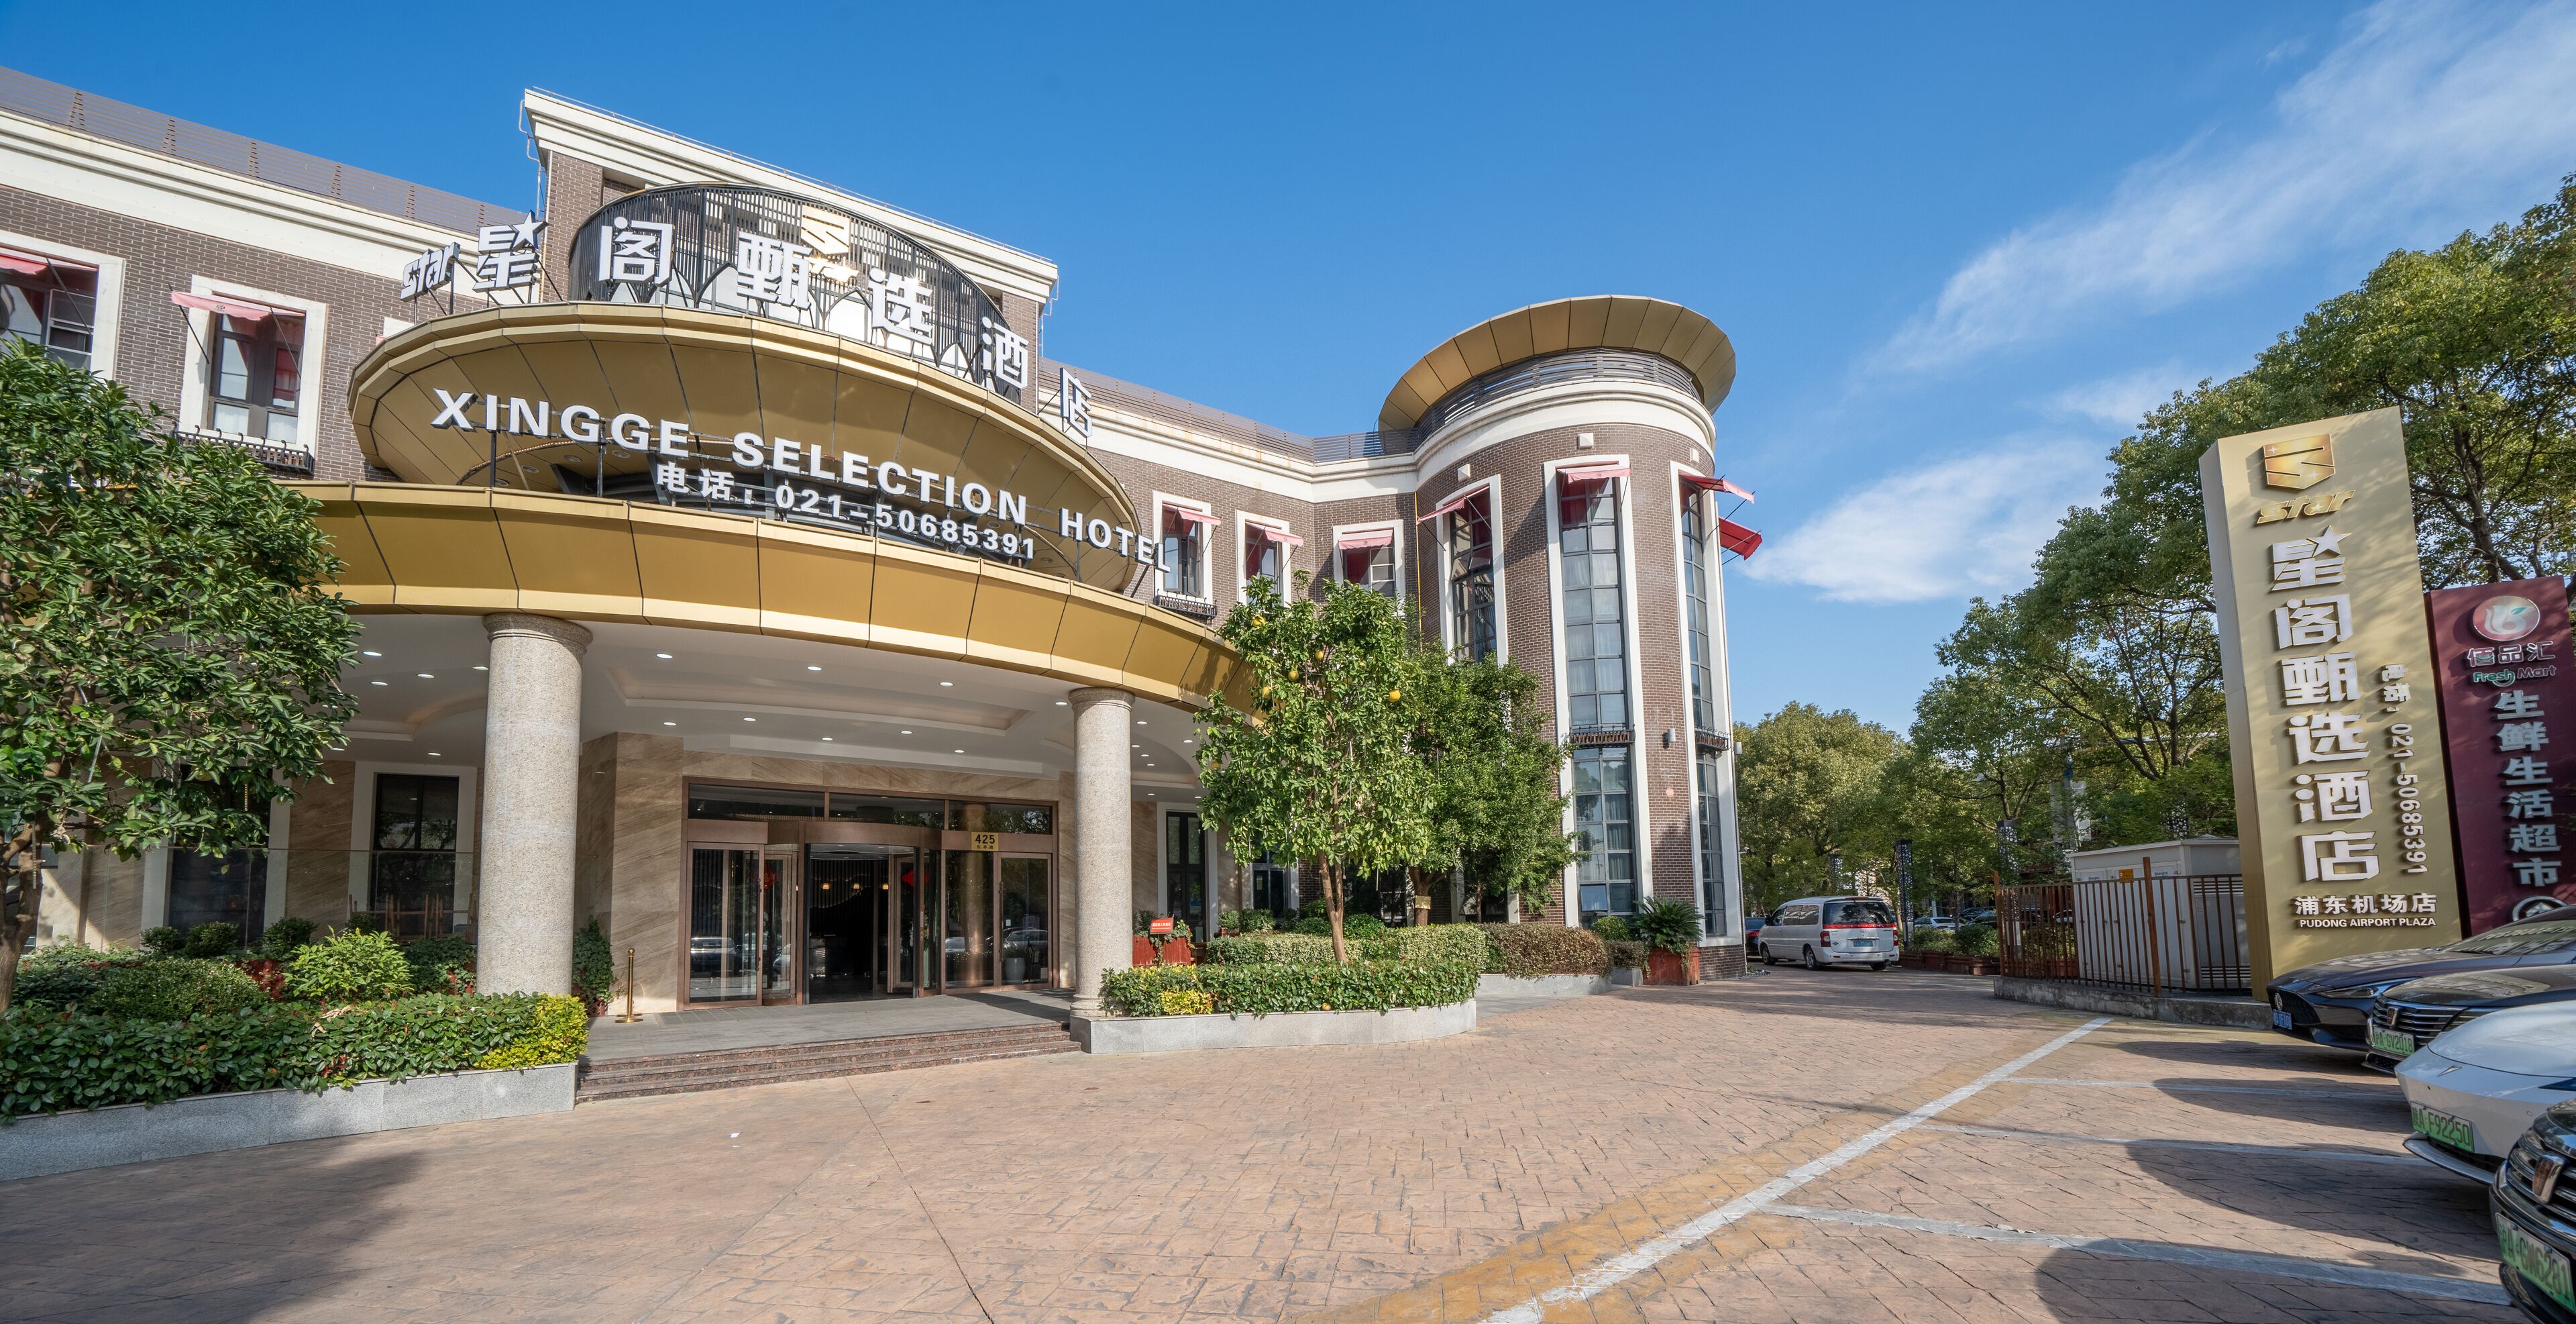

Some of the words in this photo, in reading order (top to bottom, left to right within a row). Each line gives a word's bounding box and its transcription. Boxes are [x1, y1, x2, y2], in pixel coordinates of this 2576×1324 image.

[400, 242, 460, 302] star
[472, 209, 1092, 438] 星阁甄选酒店
[430, 387, 689, 459] XINGGE
[732, 431, 1027, 527] SELECTION
[1059, 507, 1171, 574] HOTEL
[2467, 640, 2556, 668] 佰品汇
[2473, 669, 2515, 686] Fresh
[2517, 665, 2556, 679] Mart
[2271, 525, 2380, 882] 星阁甄选酒店
[2494, 689, 2562, 887] 生鲜生活超市
[975, 834, 996, 844] 425
[2294, 893, 2437, 915] 浦东机场店
[2300, 919, 2347, 927] PUDONG
[2349, 918, 2398, 927] AIRPORT
[2399, 917, 2436, 926] PLAZA
